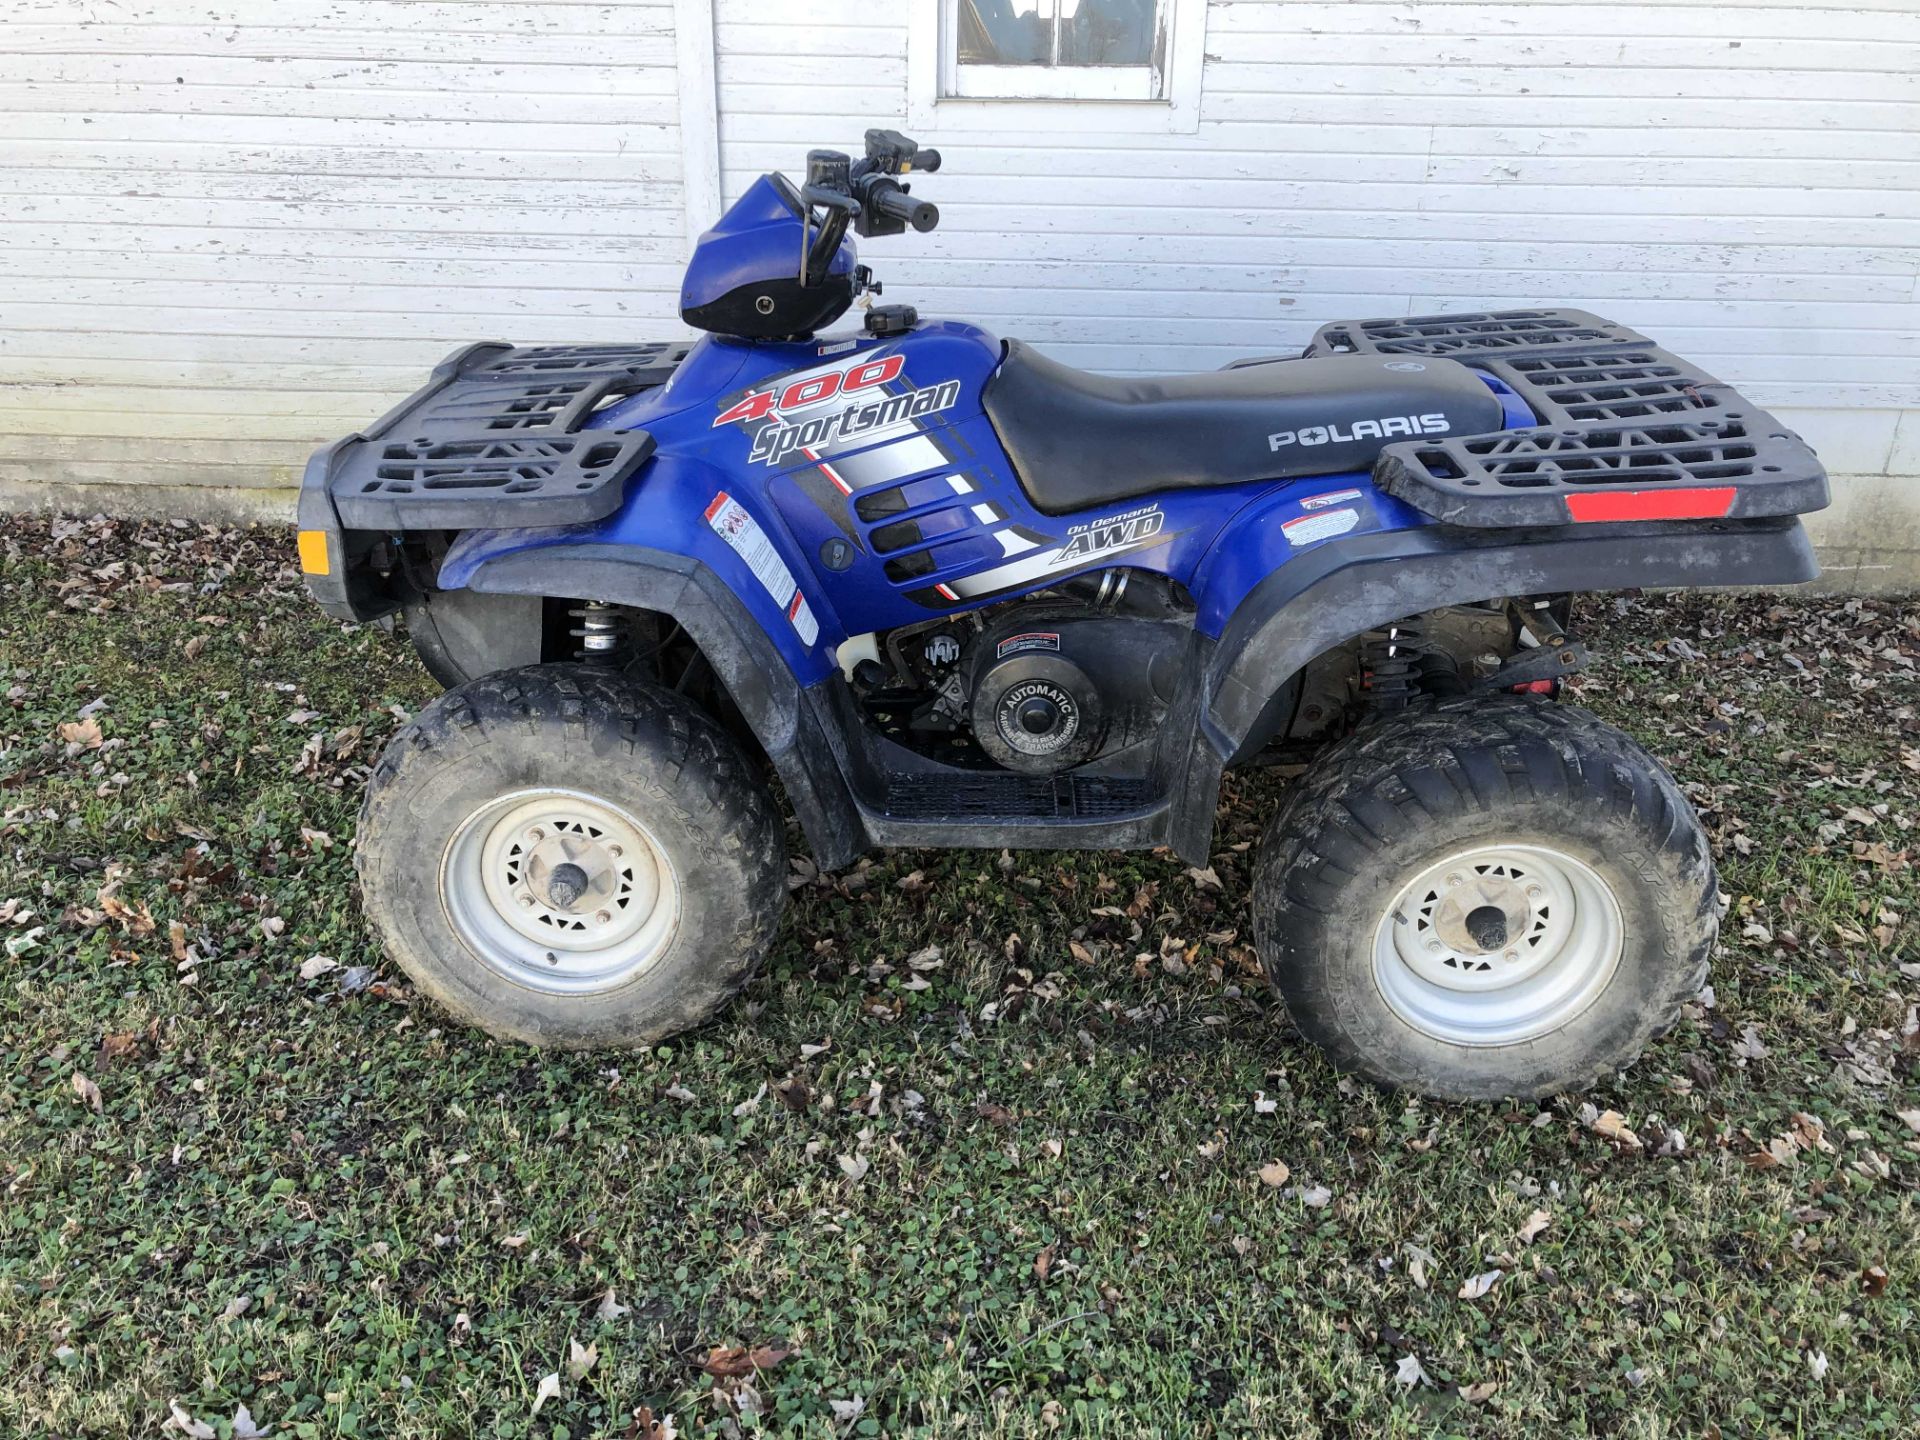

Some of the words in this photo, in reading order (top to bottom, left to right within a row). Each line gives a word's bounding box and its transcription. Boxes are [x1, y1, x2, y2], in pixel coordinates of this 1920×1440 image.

[712, 355, 905, 428] 400
[748, 380, 960, 466] Sportsman
[1268, 413, 1450, 452] POLARIS
[1049, 511, 1164, 566] AWD
[1067, 523, 1087, 535] On
[1091, 503, 1158, 529] Demand
[1006, 684, 1072, 714] AUTOMATIC
[1000, 709, 1023, 746] VARIABLE
[1025, 716, 1076, 752] TRANSMISSION
[1015, 730, 1056, 744] POLARIS
